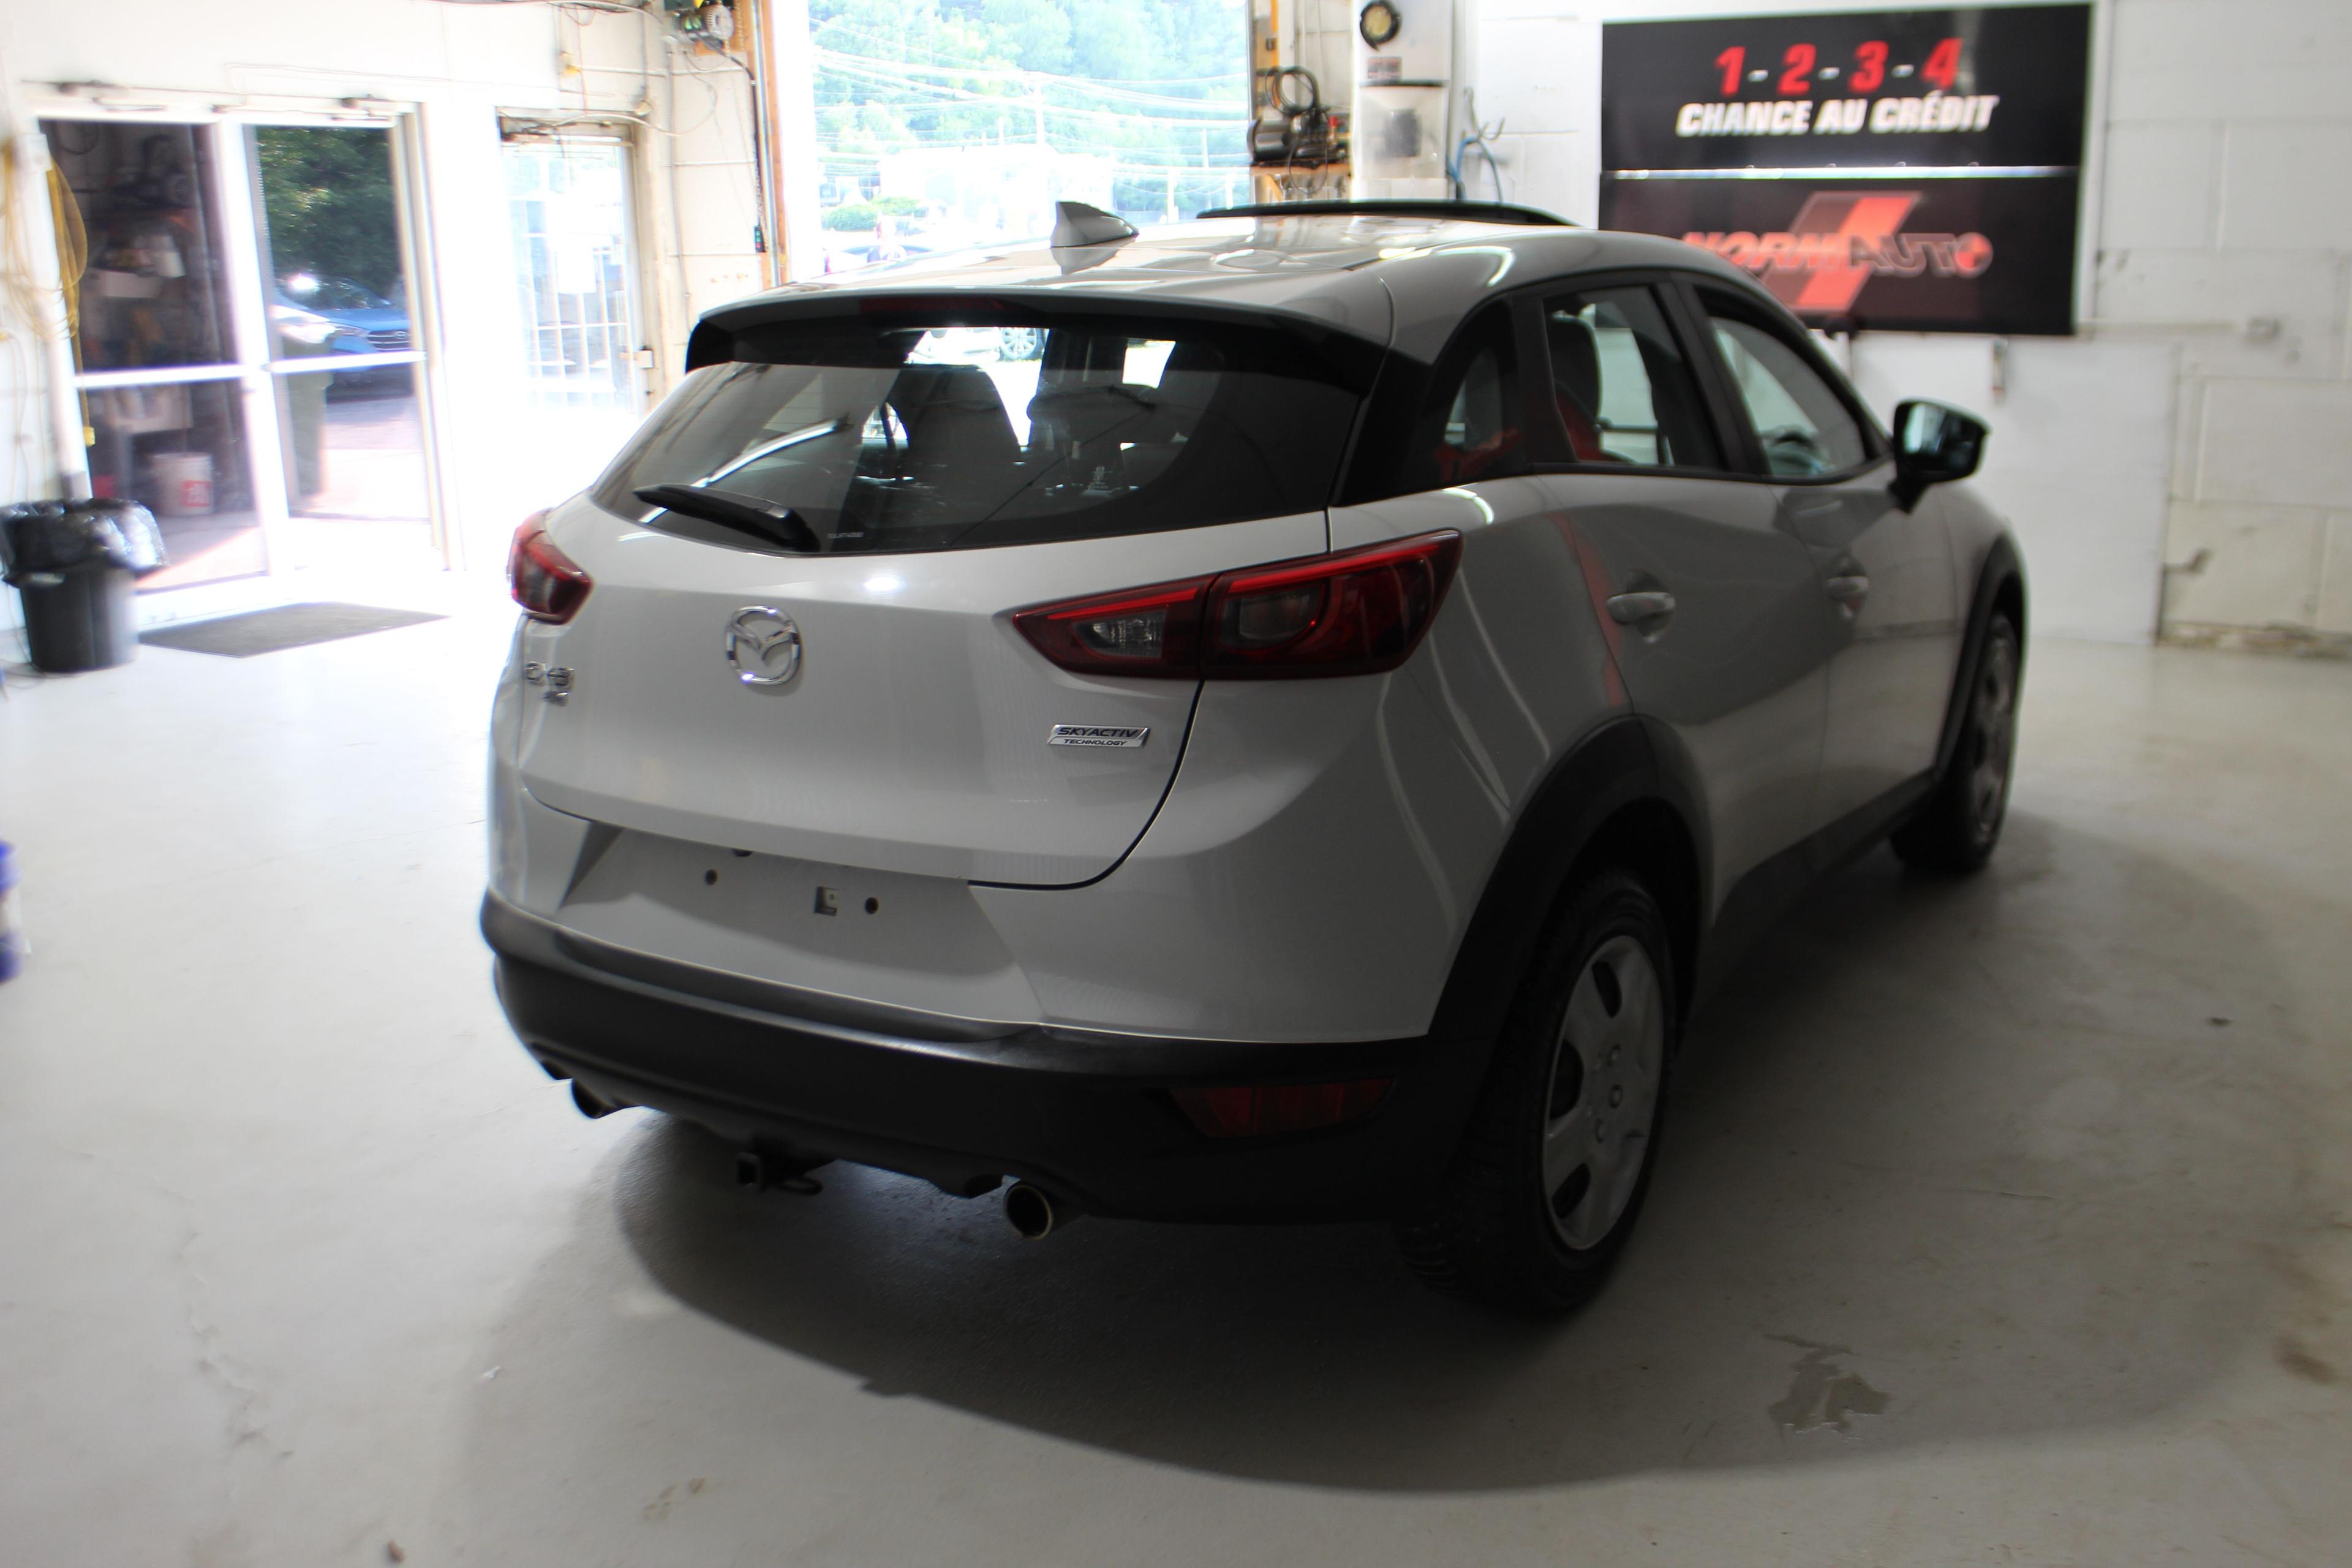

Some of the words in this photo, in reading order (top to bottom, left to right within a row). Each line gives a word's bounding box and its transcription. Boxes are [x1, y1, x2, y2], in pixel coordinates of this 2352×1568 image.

[1676, 100, 1813, 137] CHANCE
[1812, 99, 1868, 135] AU
[1869, 89, 2000, 134] CRÉDIT
[1057, 726, 1140, 737] SKYACTIV
